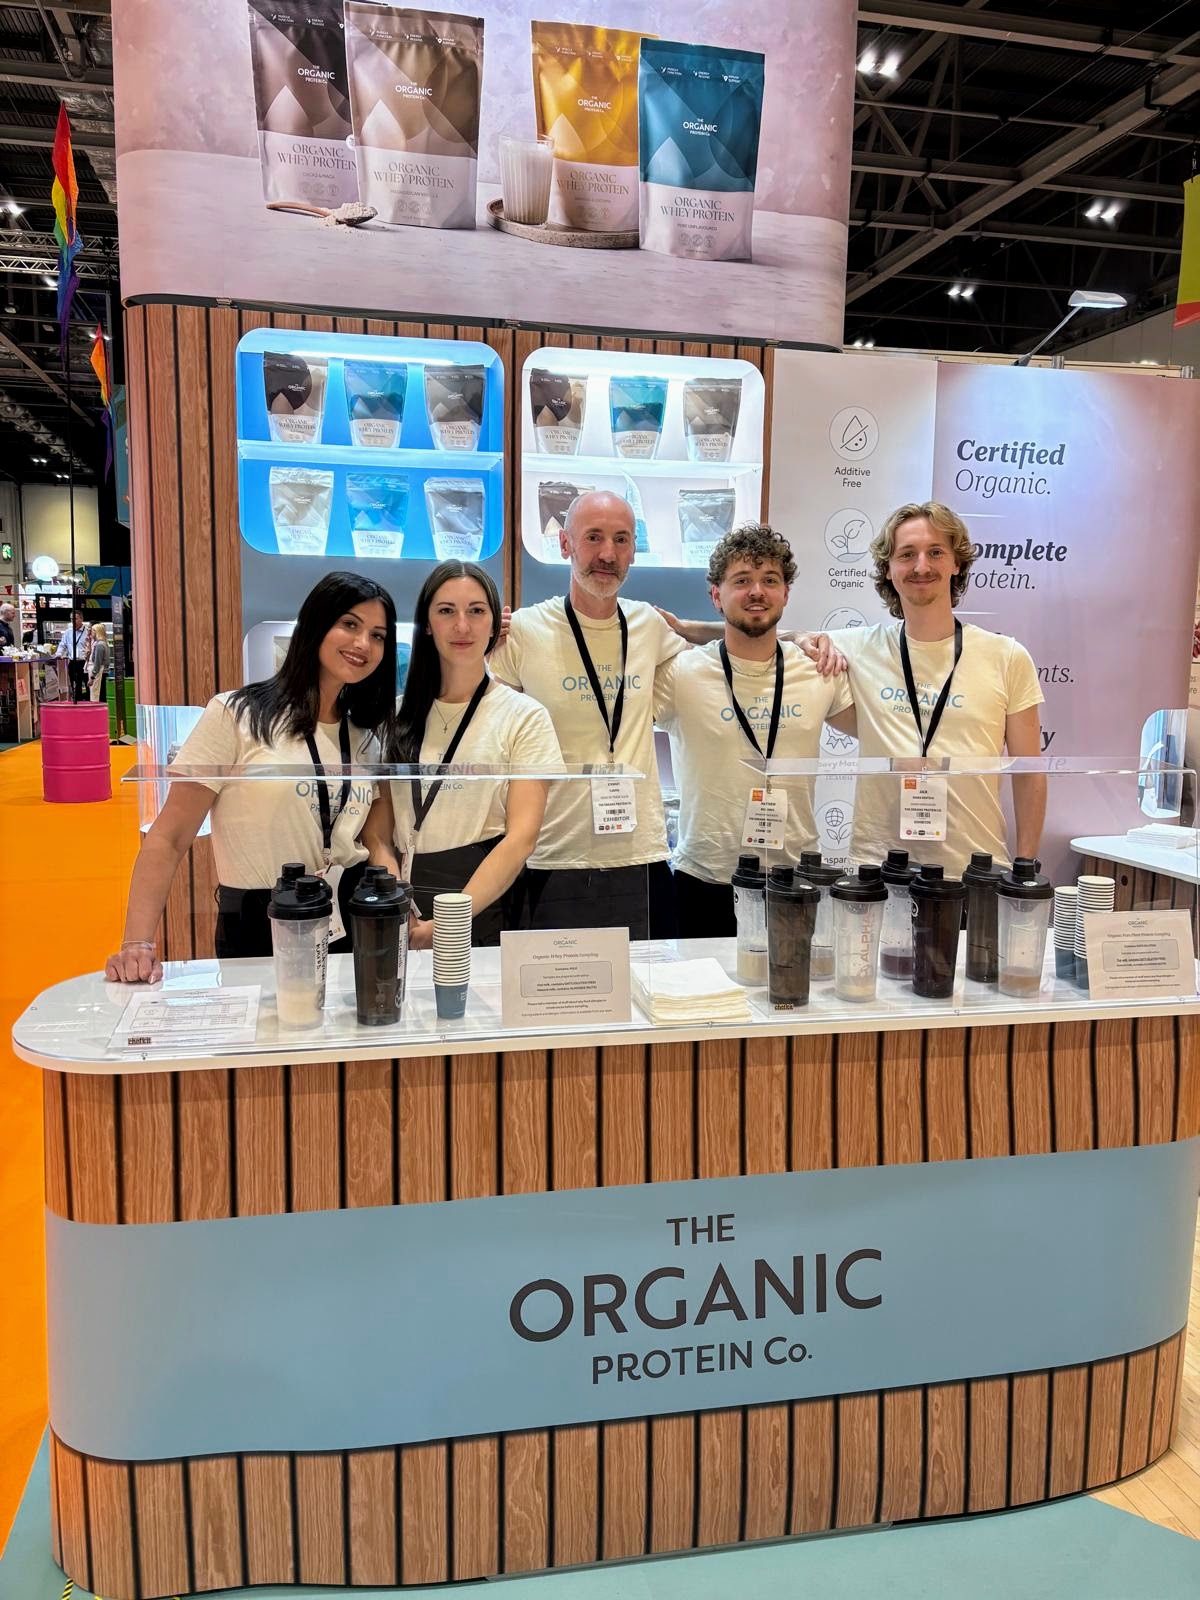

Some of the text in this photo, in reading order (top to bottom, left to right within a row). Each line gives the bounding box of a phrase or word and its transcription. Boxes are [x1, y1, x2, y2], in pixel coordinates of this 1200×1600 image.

[297, 68, 335, 79] ORGANIC
[395, 85, 432, 96] ORGANIC
[578, 99, 611, 109] ORGANIC
[683, 122, 718, 132] ORGANIC
[292, 144, 344, 158] ORGANIC
[277, 152, 357, 170] WHEY PROTEIN
[388, 162, 440, 176] ORGANIC
[374, 171, 454, 189] WHEY PROTEIN
[570, 170, 616, 183] ORGANIC
[588, 183, 629, 195] PROTEIN
[674, 196, 722, 210] ORGANIC
[660, 206, 735, 222] WHEY PROTEIN
[957, 440, 1066, 469] Certified
[835, 467, 870, 476] Additive
[842, 478, 861, 488] Free
[956, 469, 1051, 498] Organic.
[972, 539, 1067, 566] omplete
[828, 568, 867, 577] Certified
[968, 567, 1035, 589] rotein.
[830, 579, 864, 589] Organic
[562, 675, 641, 691] ORANIC
[880, 687, 964, 708] ORANIC
[721, 704, 802, 721] OGANIC
[893, 705, 930, 716] PROIN
[311, 803, 348, 814] PREN
[665, 1213, 735, 1246] THE
[509, 1248, 882, 1342] ORGANIC
[592, 1336, 813, 1385] PROTEIN Co.
